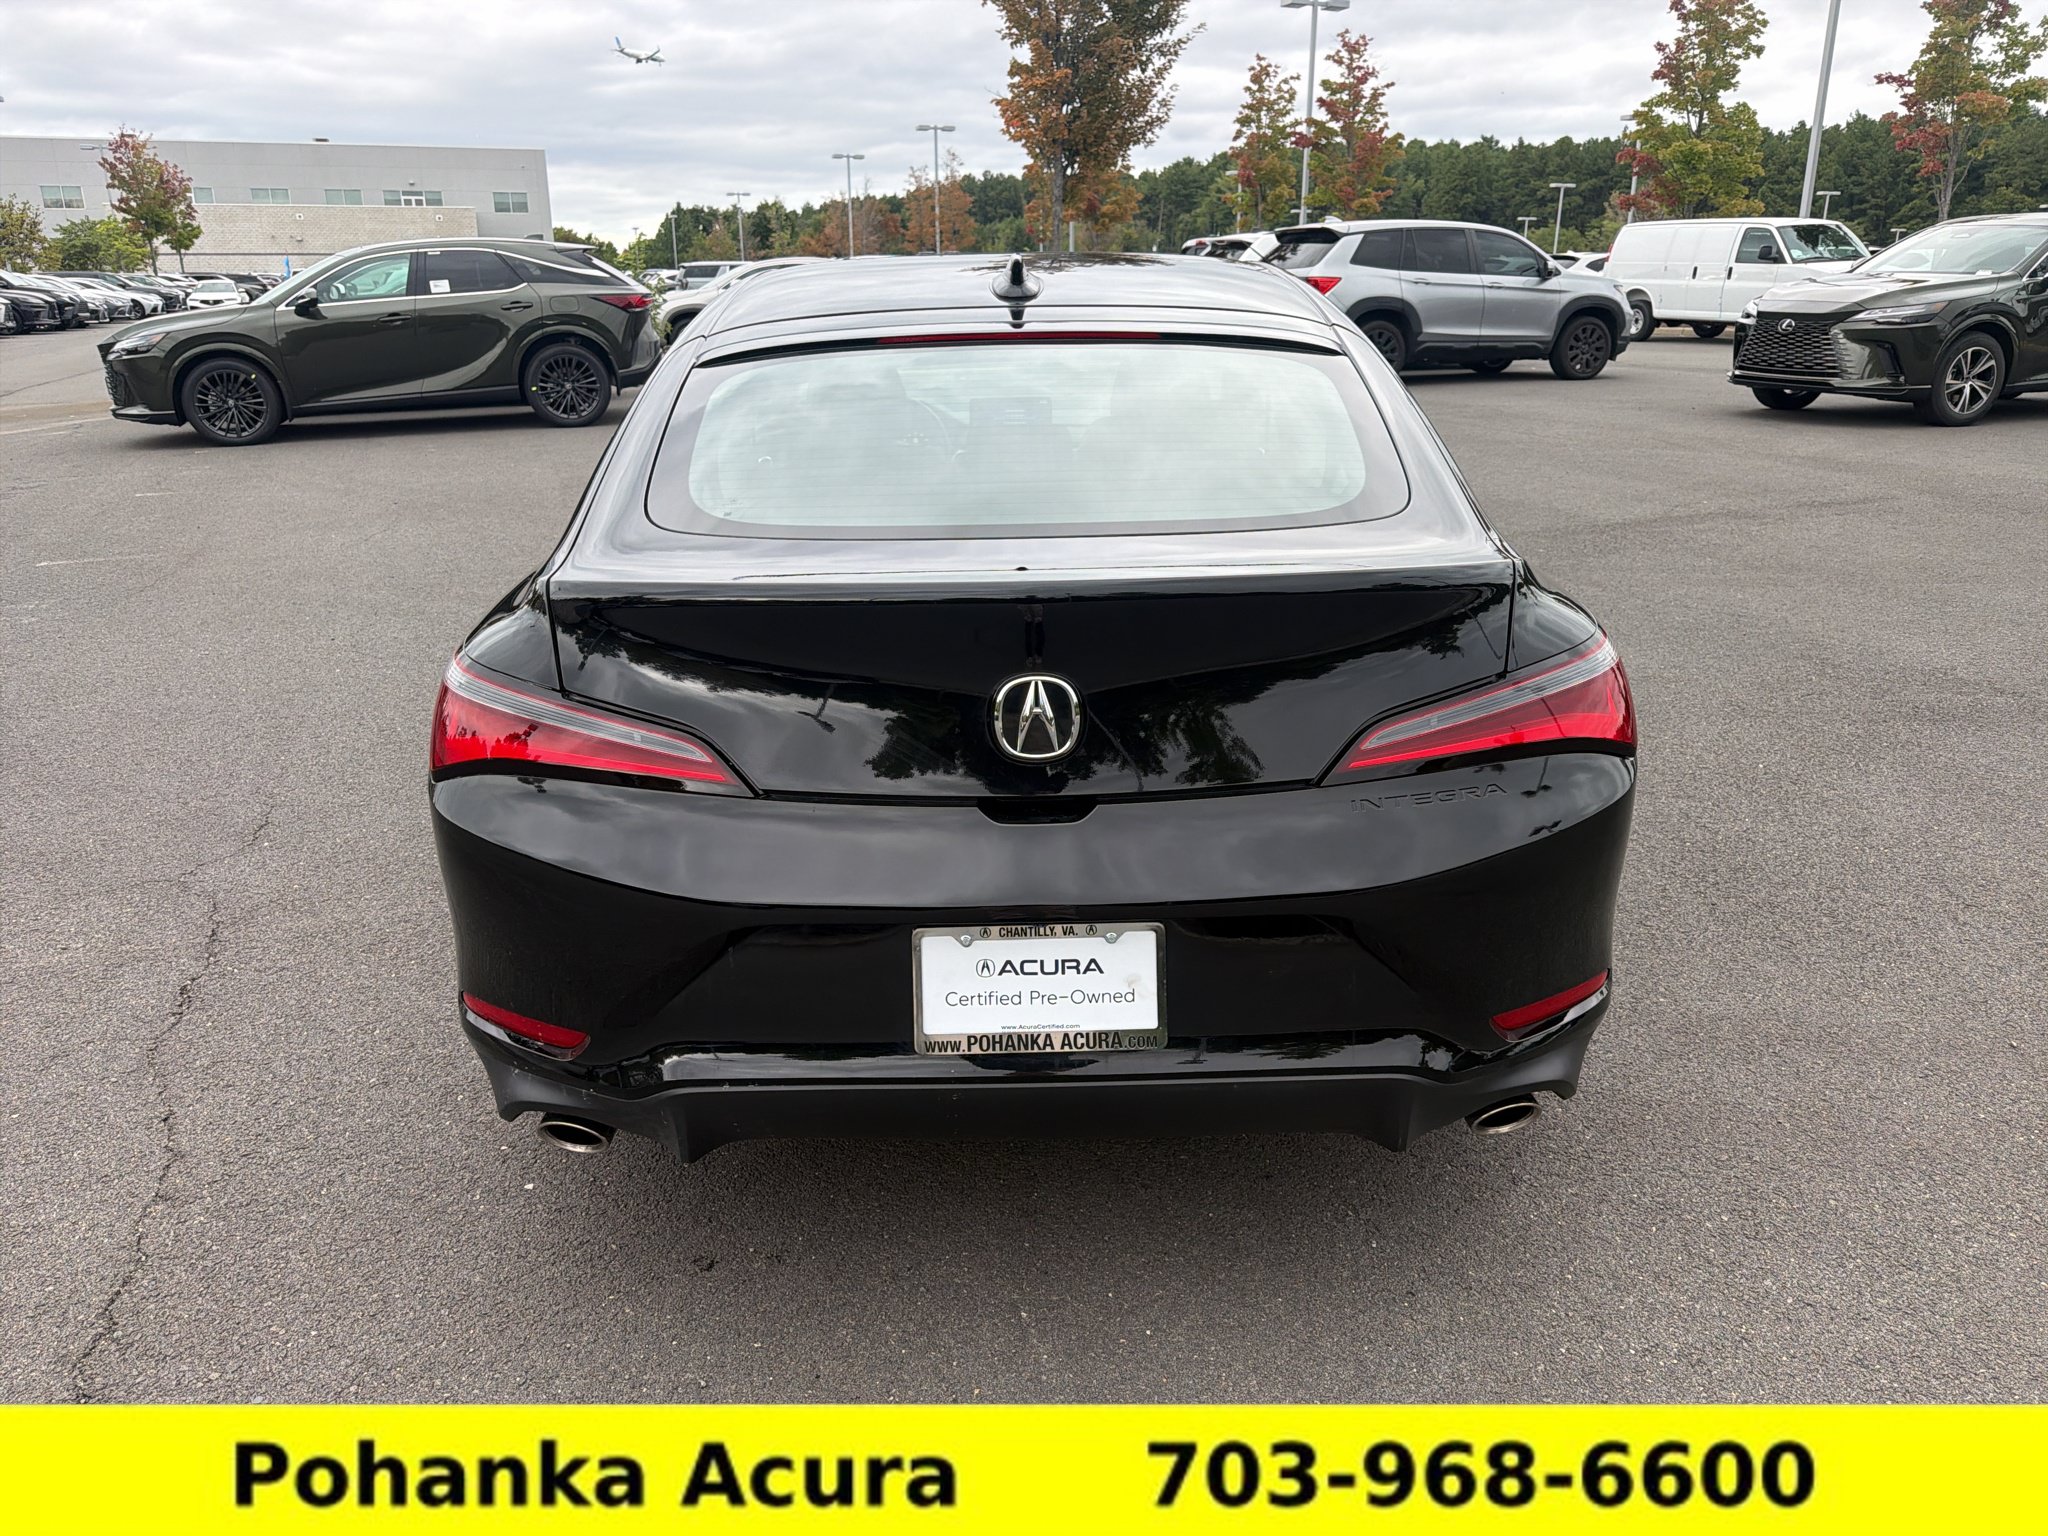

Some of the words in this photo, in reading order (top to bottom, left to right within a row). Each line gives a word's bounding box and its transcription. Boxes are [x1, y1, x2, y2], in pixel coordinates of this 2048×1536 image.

[1351, 783, 1507, 812] INTEGRA
[999, 926, 1057, 938] CHANTILLY,
[1062, 925, 1078, 936] VA.
[998, 958, 1104, 976] ACURA
[945, 991, 1022, 1007] Certified
[1029, 988, 1136, 1006] Pre-Owned
[1000, 1023, 1081, 1031] www.AcuraCertified.com
